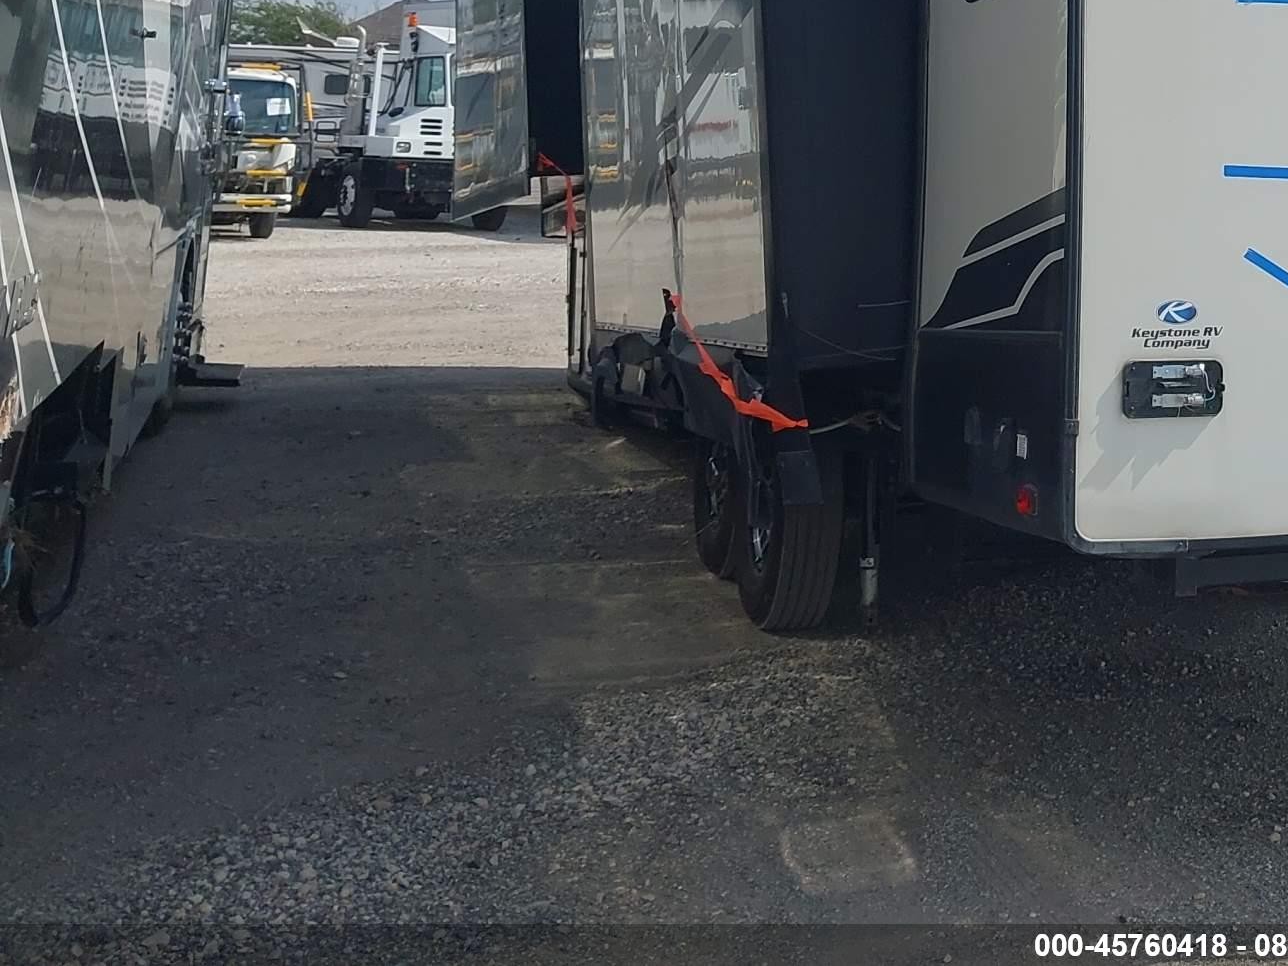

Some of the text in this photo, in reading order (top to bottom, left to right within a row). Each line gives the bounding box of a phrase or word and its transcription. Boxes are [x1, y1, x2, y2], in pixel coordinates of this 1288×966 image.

[1131, 326, 1223, 340] Keystone RV
[1143, 338, 1211, 349] Company
